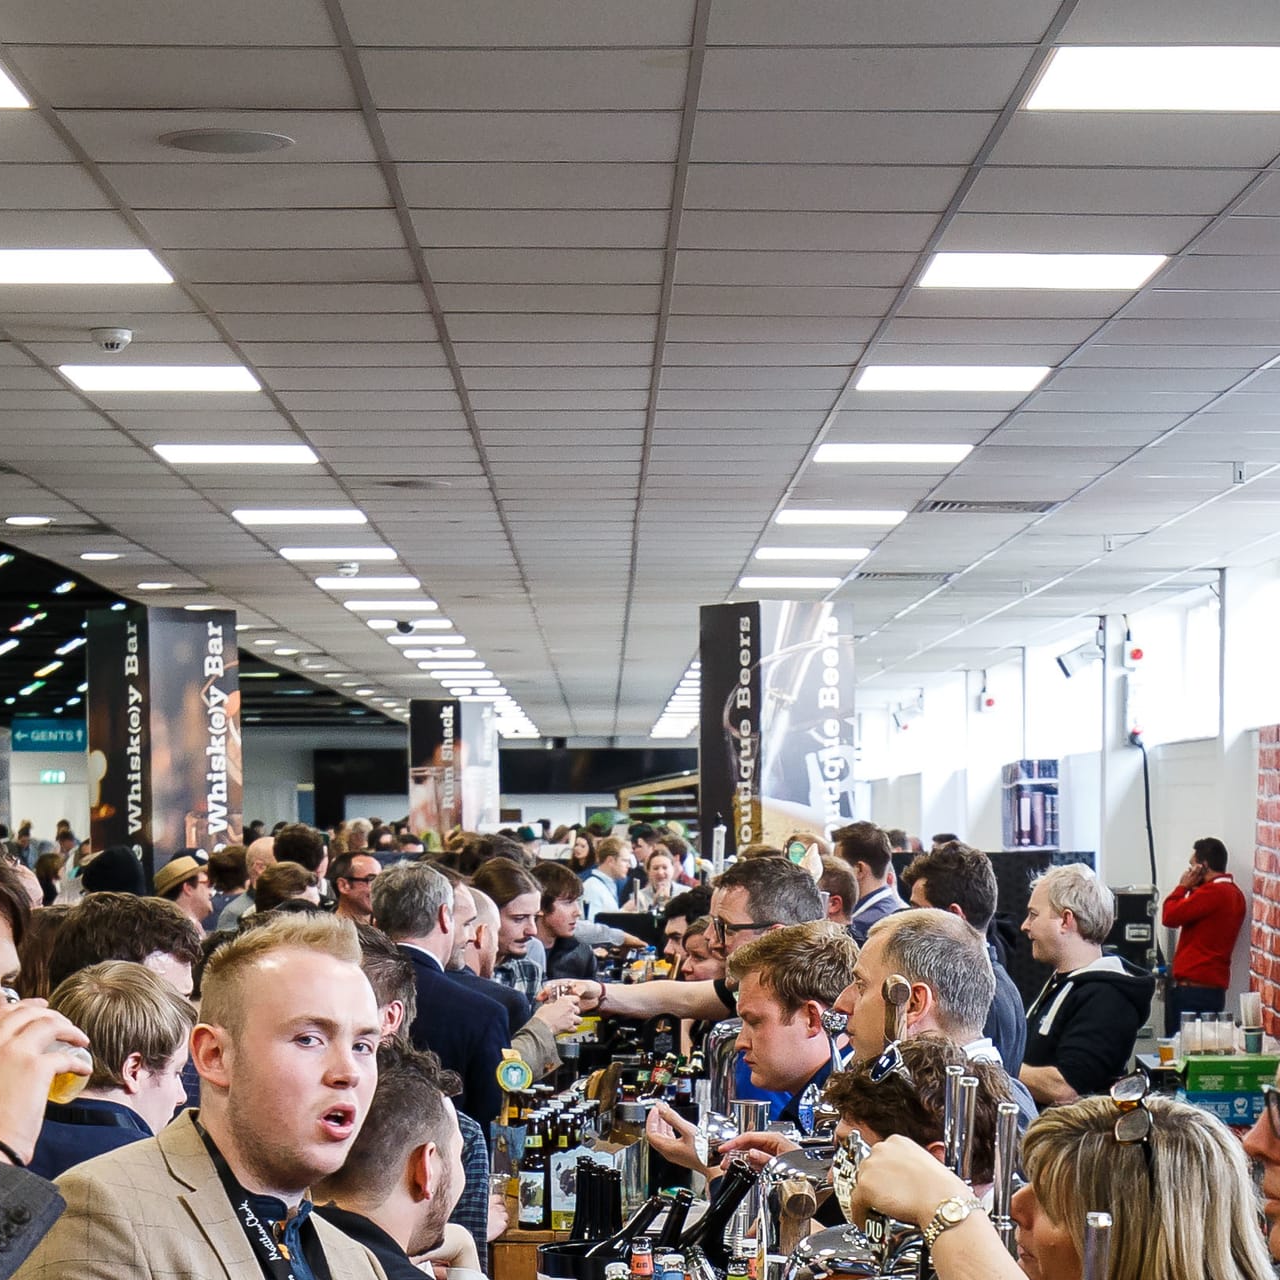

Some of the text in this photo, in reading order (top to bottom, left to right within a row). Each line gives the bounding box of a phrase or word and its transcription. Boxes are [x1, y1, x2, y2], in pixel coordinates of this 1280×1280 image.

[125, 621, 139, 676] Bar
[31, 730, 74, 742] GENTS
[128, 684, 142, 835] Whisk(e)y
[204, 621, 229, 836] Whisk(e)y Bar
[440, 705, 455, 809] Rum Shack
[737, 616, 754, 850] outique Beers
[818, 616, 846, 850] outique Beers
[865, 1219, 882, 1243] OLD
